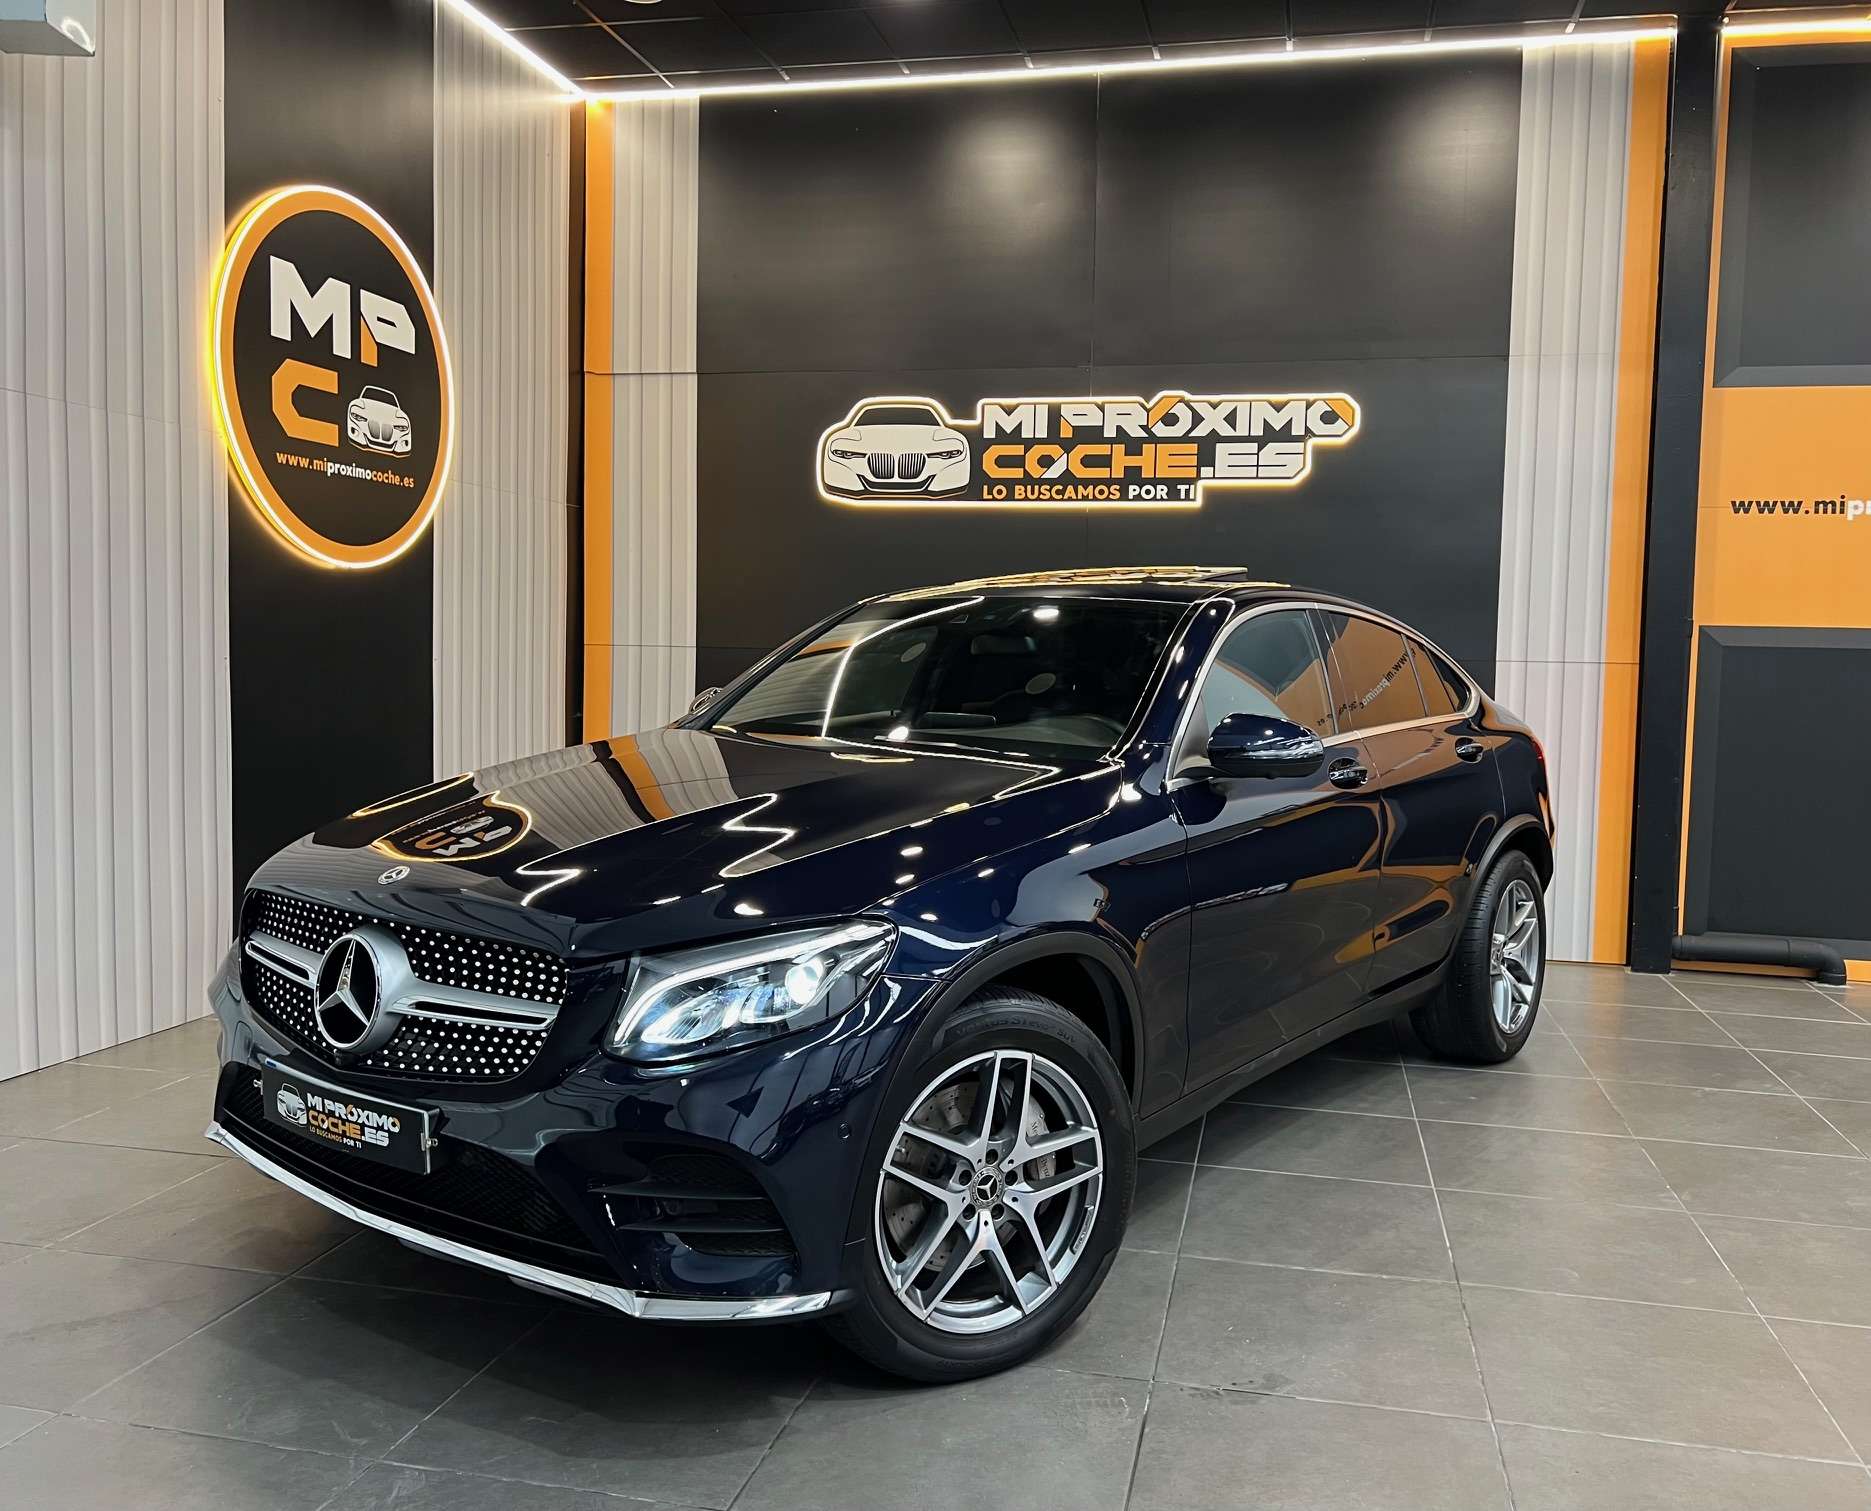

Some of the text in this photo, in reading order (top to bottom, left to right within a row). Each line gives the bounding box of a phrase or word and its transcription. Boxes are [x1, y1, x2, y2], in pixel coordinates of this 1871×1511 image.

[271, 358, 339, 447] C
[983, 402, 1048, 438] MI
[276, 451, 415, 488] www.miproximocoche.es
[982, 442, 1305, 478] COCHE.ES
[983, 484, 1195, 500] LO BUSCAMOS POR TI
[306, 1092, 323, 1112] MI
[308, 1110, 390, 1147] COCHE.ES
